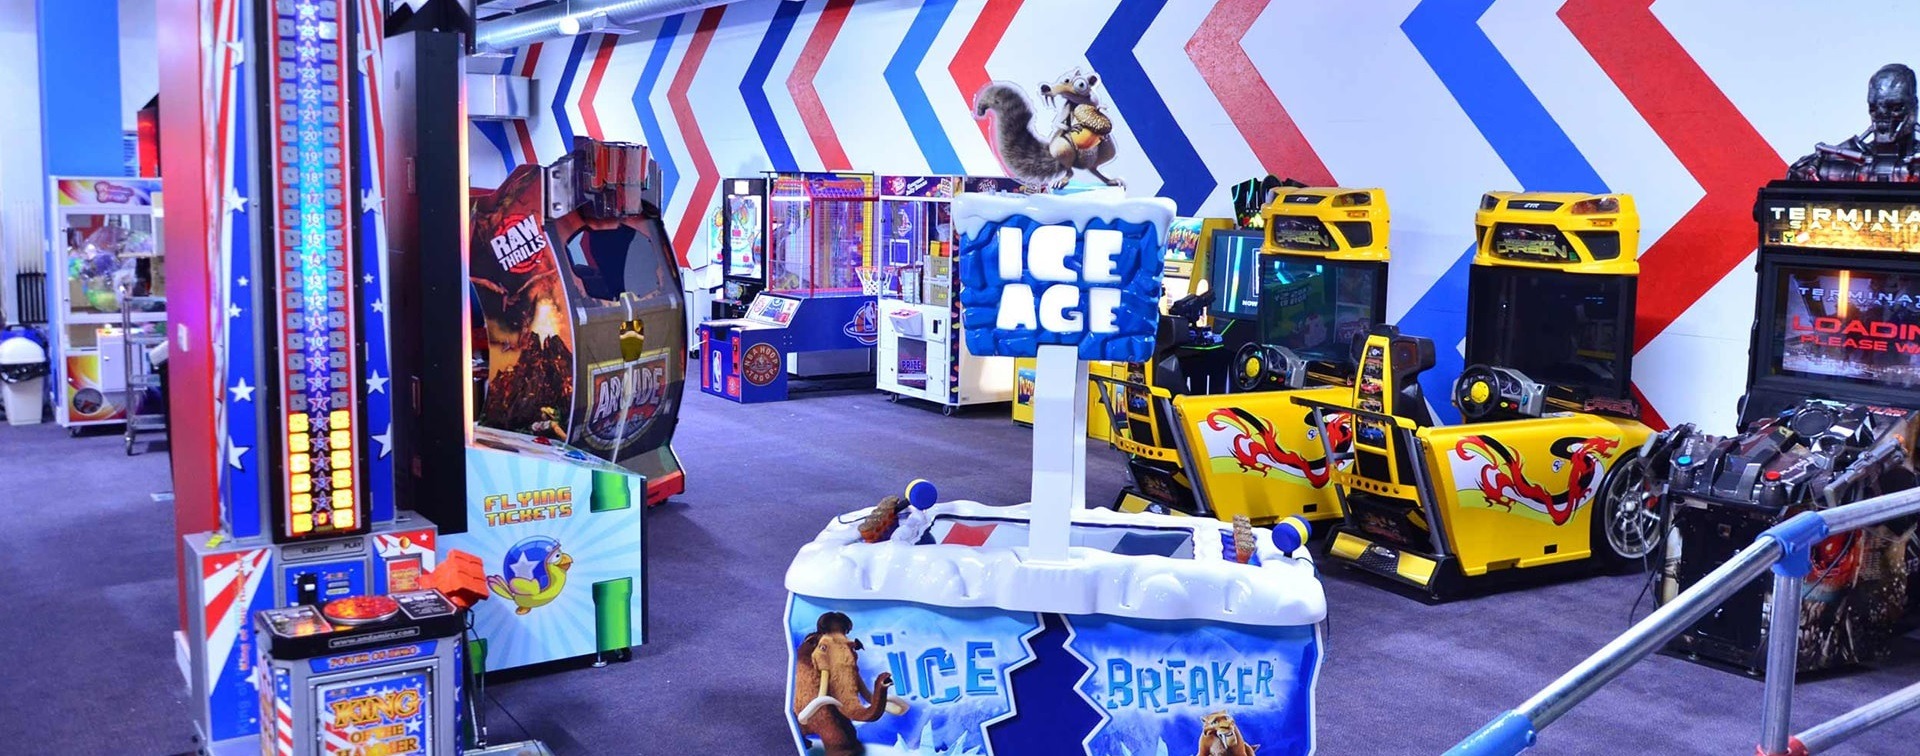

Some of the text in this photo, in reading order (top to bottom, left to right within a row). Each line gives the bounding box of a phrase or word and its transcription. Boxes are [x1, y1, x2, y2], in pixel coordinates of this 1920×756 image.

[490, 214, 540, 260] RAW
[498, 234, 546, 272] THRILLS
[998, 225, 1123, 283] ICE
[1496, 242, 1568, 258] CARBON
[996, 283, 1123, 333] AGE
[1800, 334, 1888, 352] PLEASE
[744, 346, 778, 366] NBA HOOP
[901, 360, 921, 370] PRIZE
[748, 368, 776, 381] TROOP
[484, 486, 572, 513] FLYING
[485, 503, 573, 527] TICKETS
[344, 541, 361, 549] PLAY
[333, 629, 416, 647] www.andamiro.com
[871, 632, 999, 705] ICE
[1106, 657, 1276, 713] BREAKER
[333, 688, 420, 729] KING
[336, 737, 418, 756] HAER
[351, 729, 370, 744] OF
